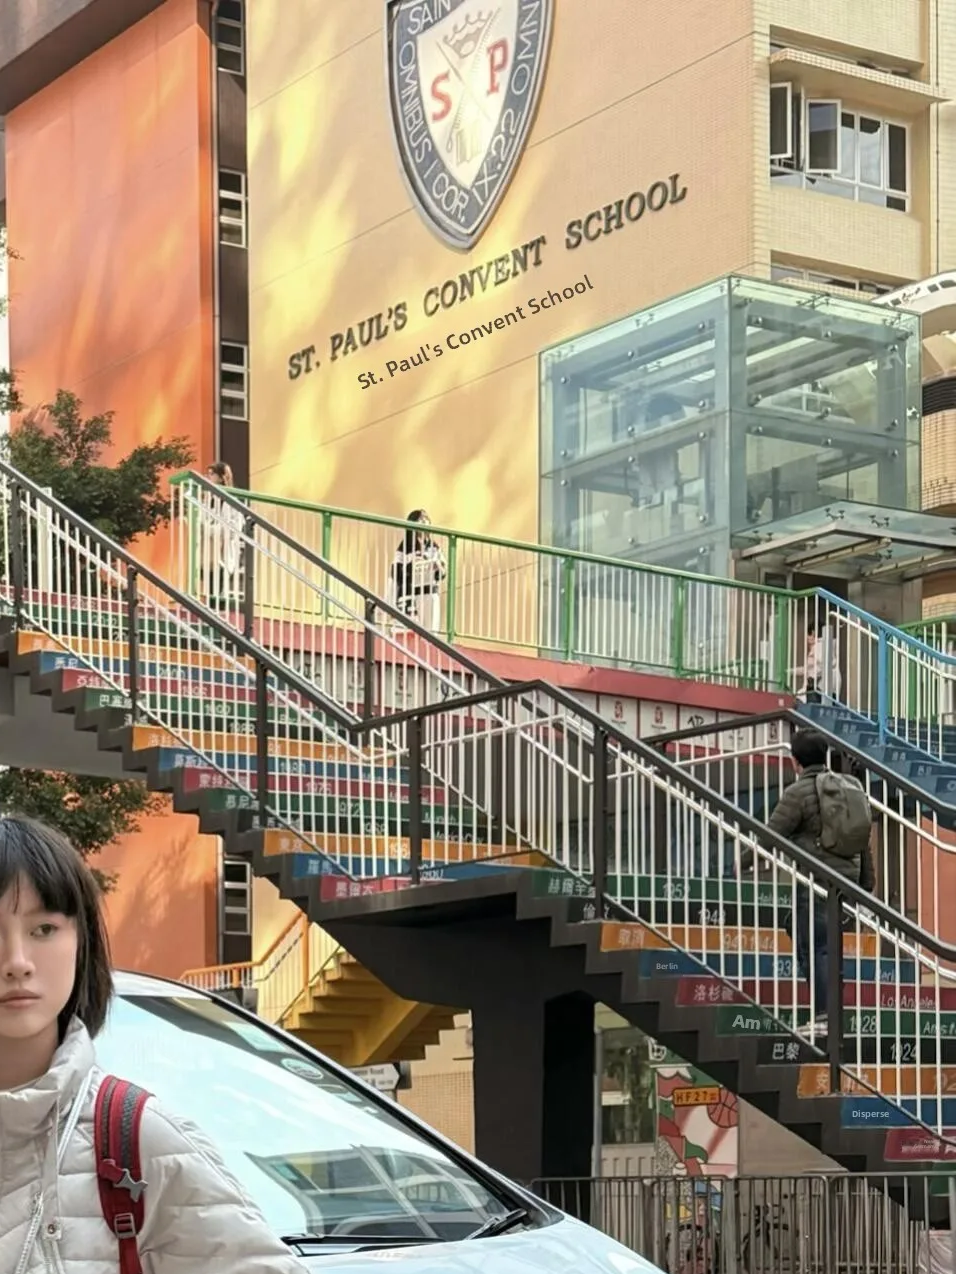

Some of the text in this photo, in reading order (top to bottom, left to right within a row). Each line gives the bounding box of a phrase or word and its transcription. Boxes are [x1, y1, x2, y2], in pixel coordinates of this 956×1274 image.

[399, 41, 432, 163] OMNIBUS
[430, 37, 509, 122] S P
[288, 173, 688, 381] ST. PAUL'S CONVENT SCHOOL
[772, 1042, 800, 1061] 巴黎
